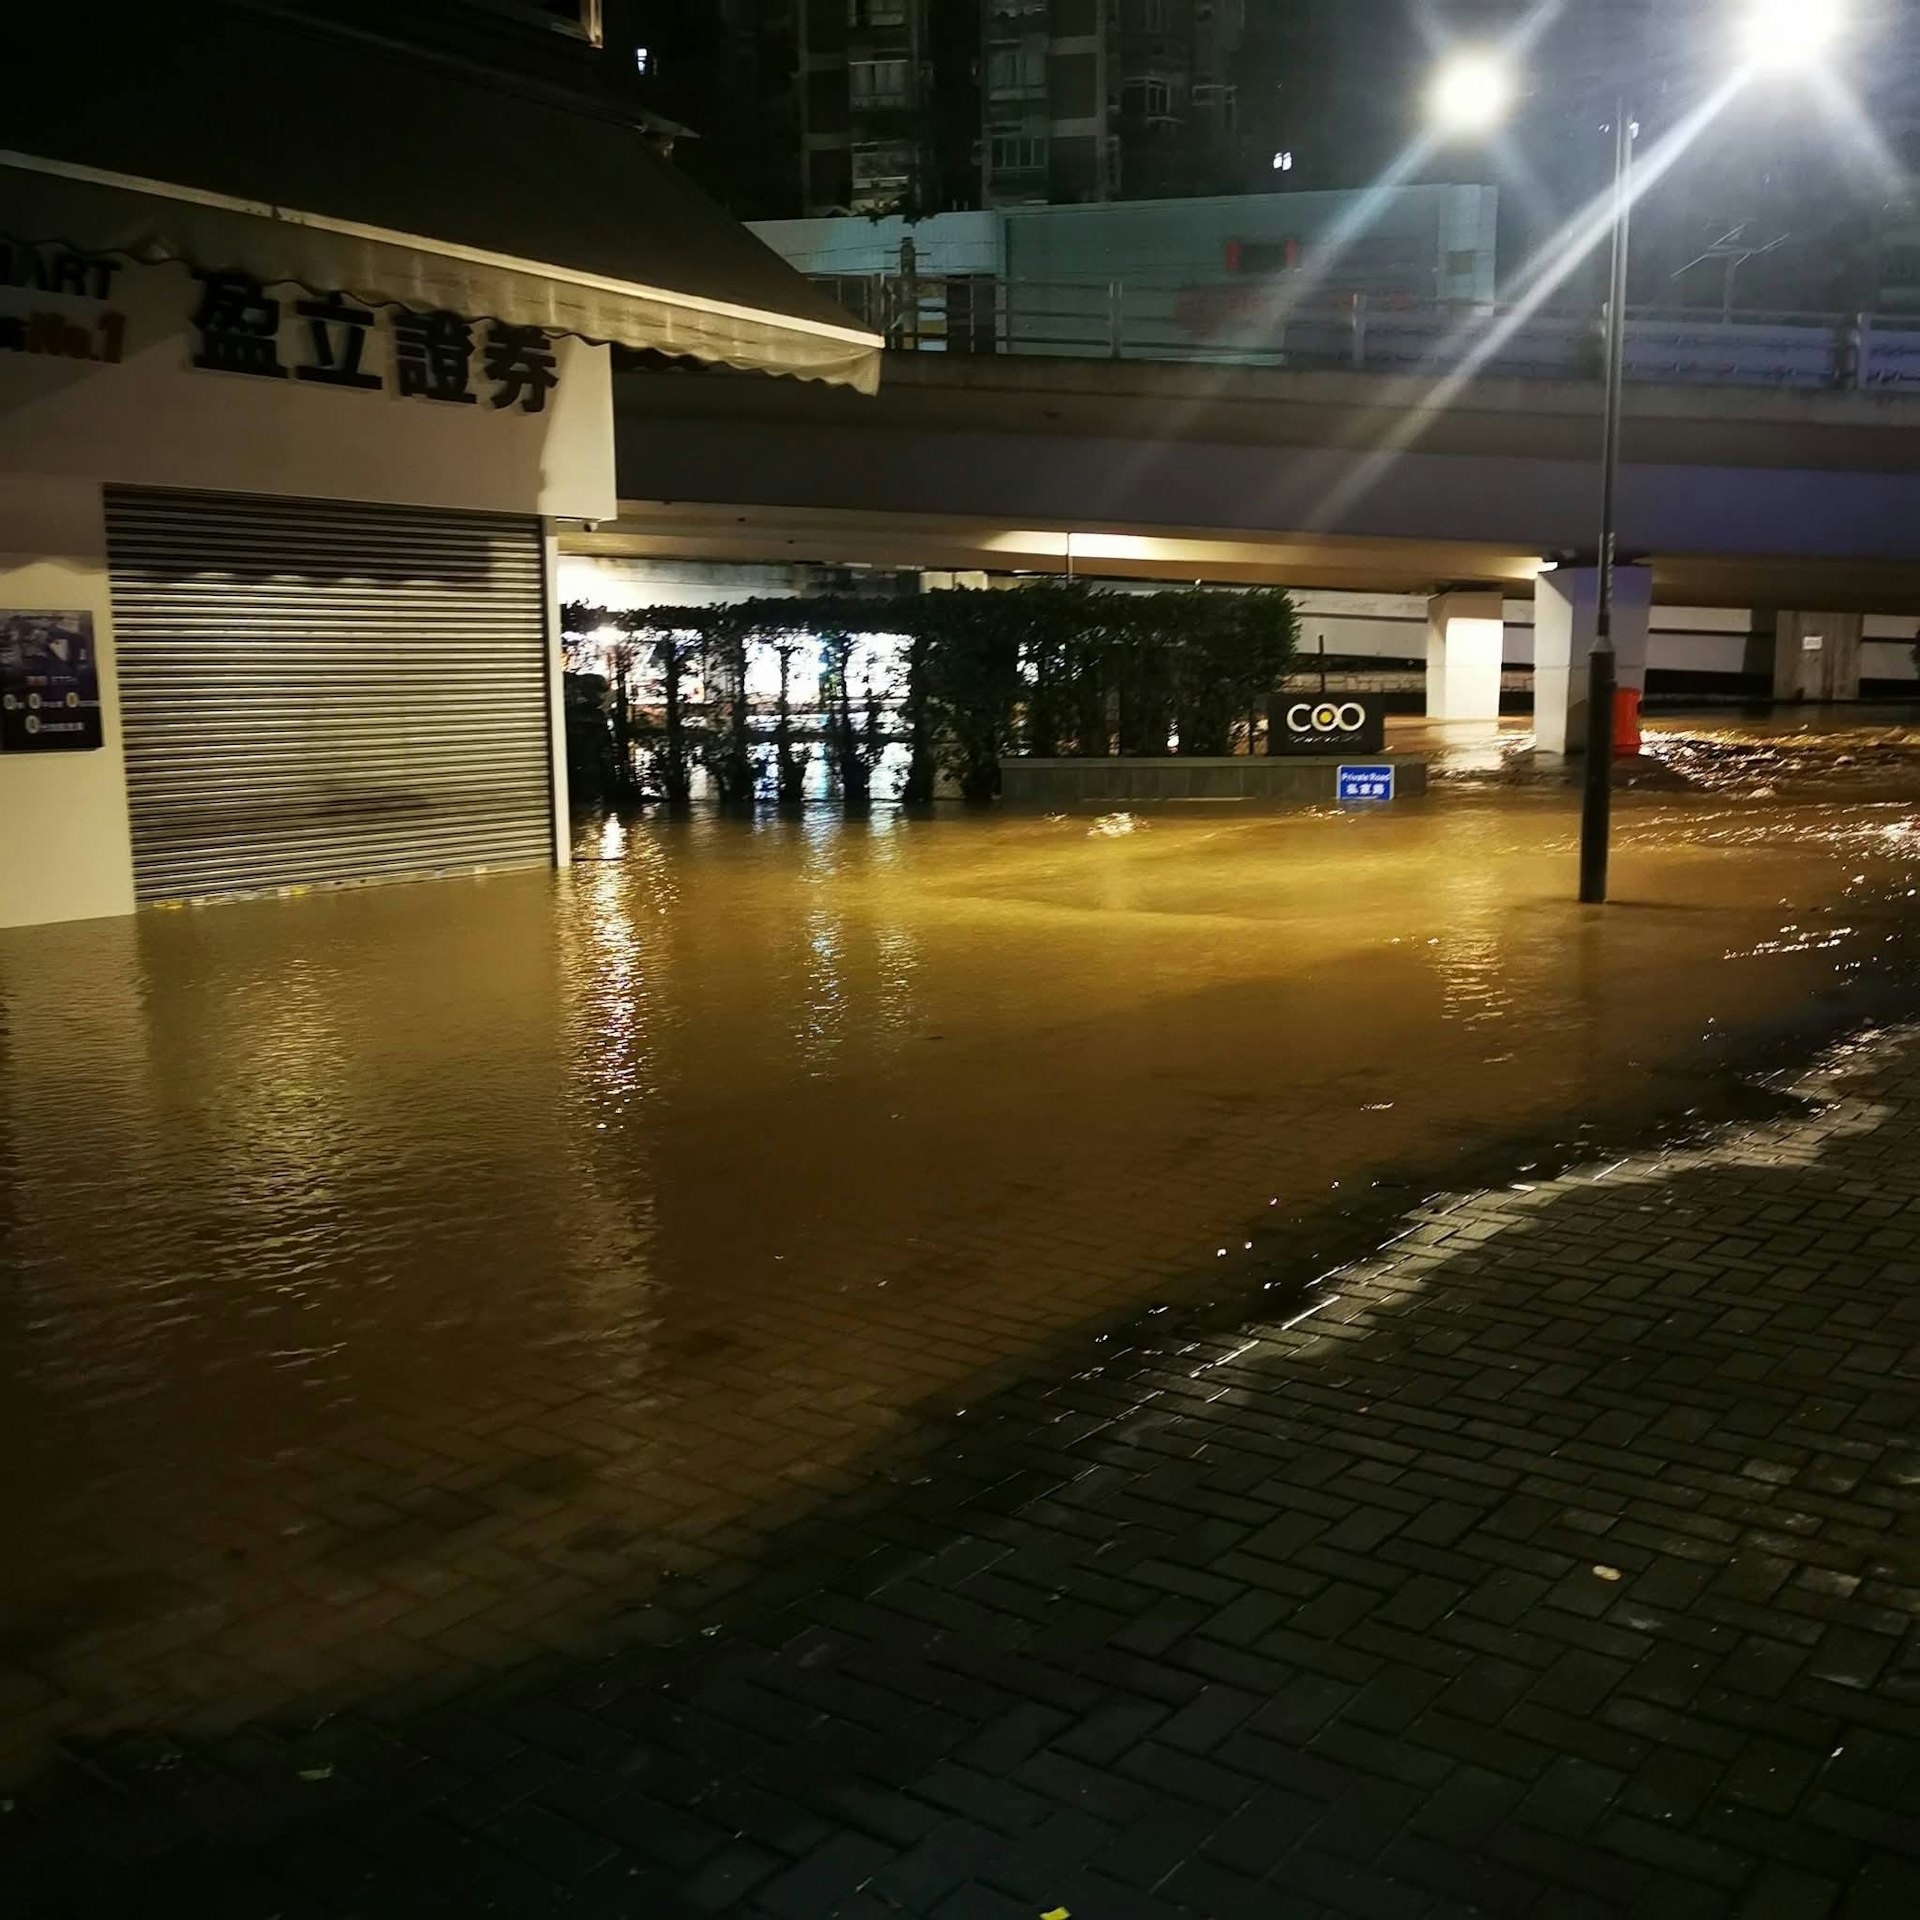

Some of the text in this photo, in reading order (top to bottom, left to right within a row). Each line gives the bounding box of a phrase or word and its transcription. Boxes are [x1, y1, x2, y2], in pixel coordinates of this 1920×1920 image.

[193, 272, 558, 412] 盈立證券
[1286, 702, 1366, 732] COO
